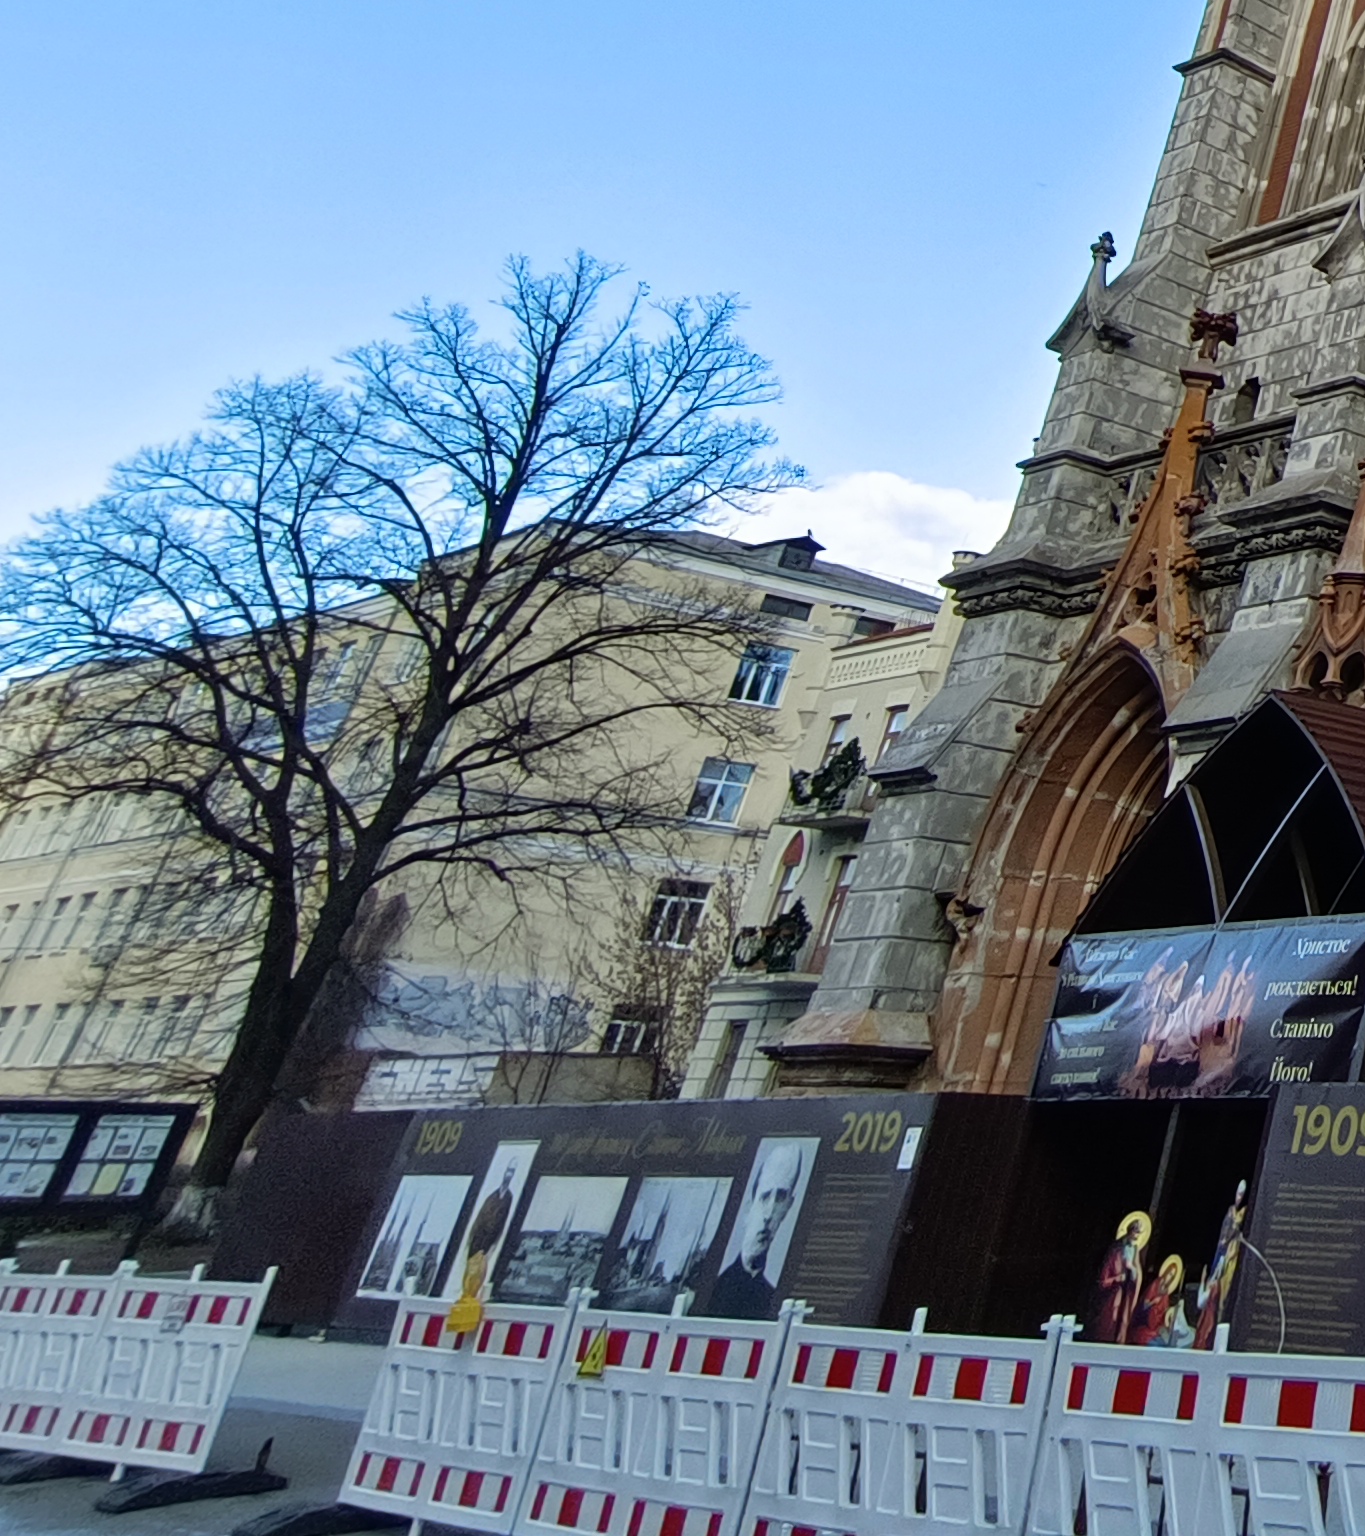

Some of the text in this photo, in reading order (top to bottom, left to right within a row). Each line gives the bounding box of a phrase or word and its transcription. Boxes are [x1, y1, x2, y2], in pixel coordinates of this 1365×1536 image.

[1292, 938, 1350, 959] Христос
[1264, 975, 1358, 1000] рождається!
[1270, 1018, 1333, 1038] Славімо
[1269, 1056, 1313, 1082] Його!
[415, 1120, 464, 1155] 1909
[834, 1110, 902, 1153] 2019
